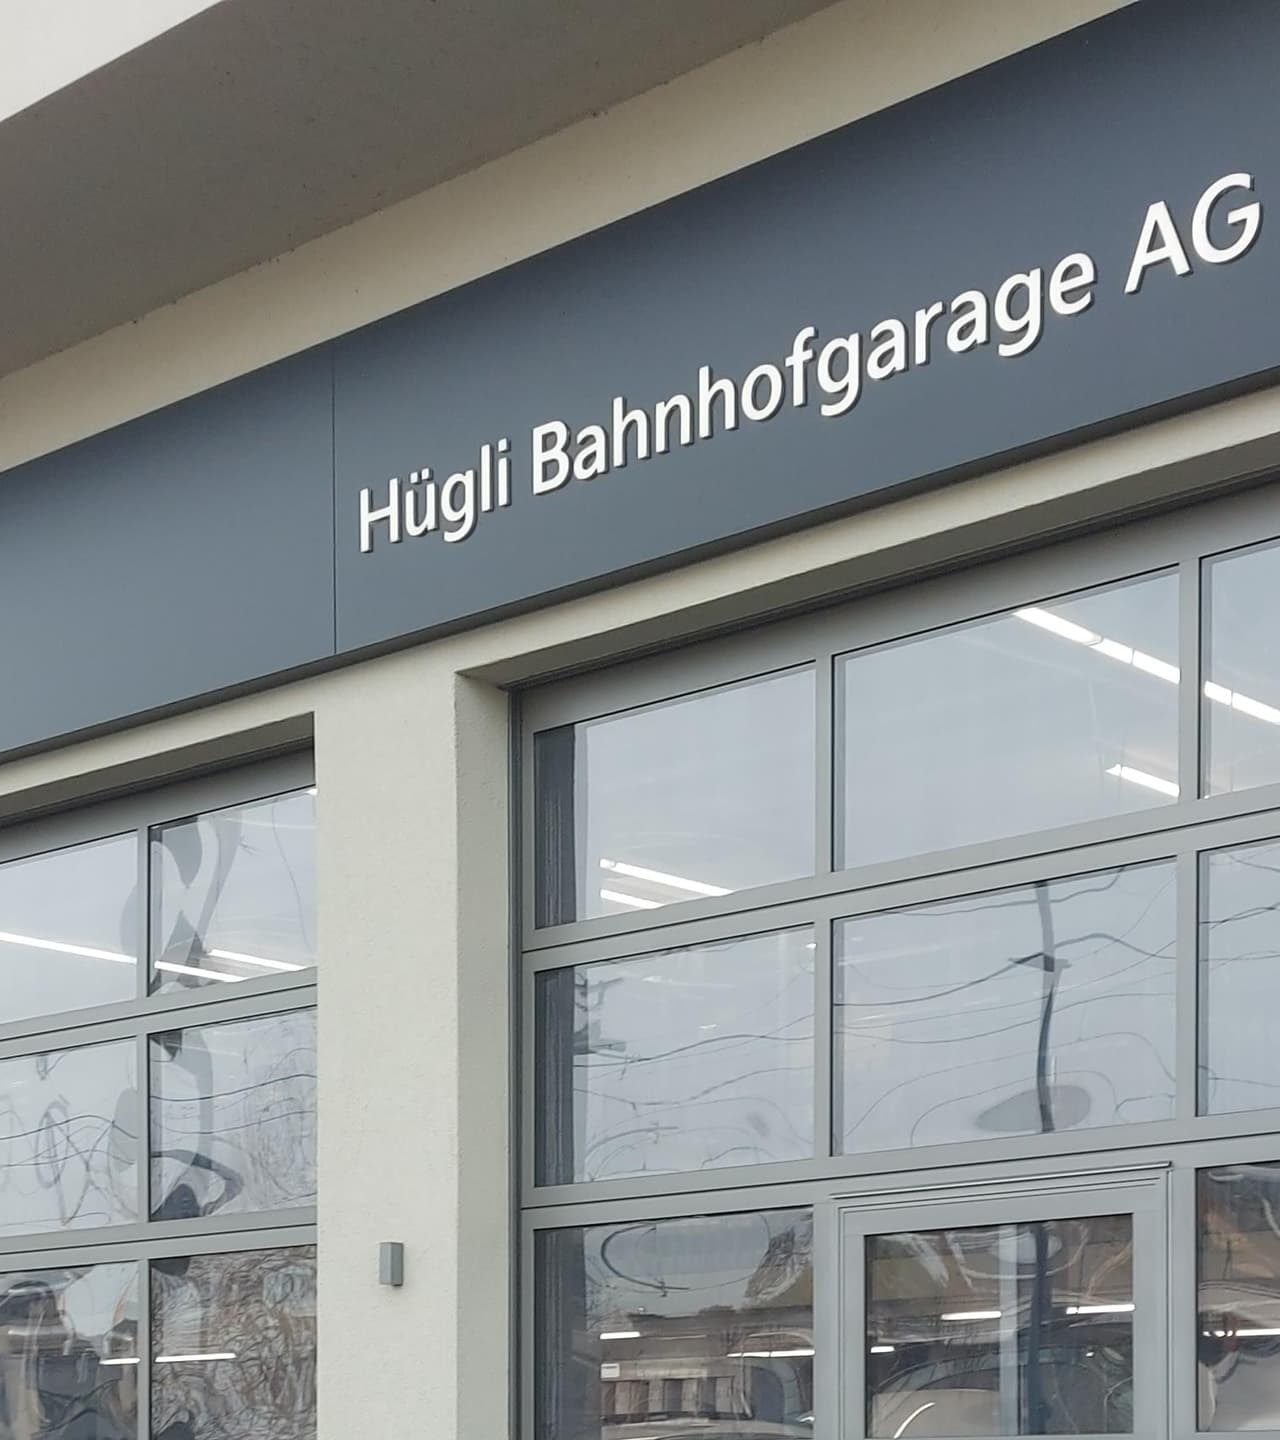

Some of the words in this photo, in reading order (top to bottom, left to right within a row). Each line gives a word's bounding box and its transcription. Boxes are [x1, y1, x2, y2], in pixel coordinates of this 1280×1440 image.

[358, 437, 511, 553] Hügli
[530, 250, 1097, 496] Bahnhofgarage
[1124, 172, 1263, 294] AG
